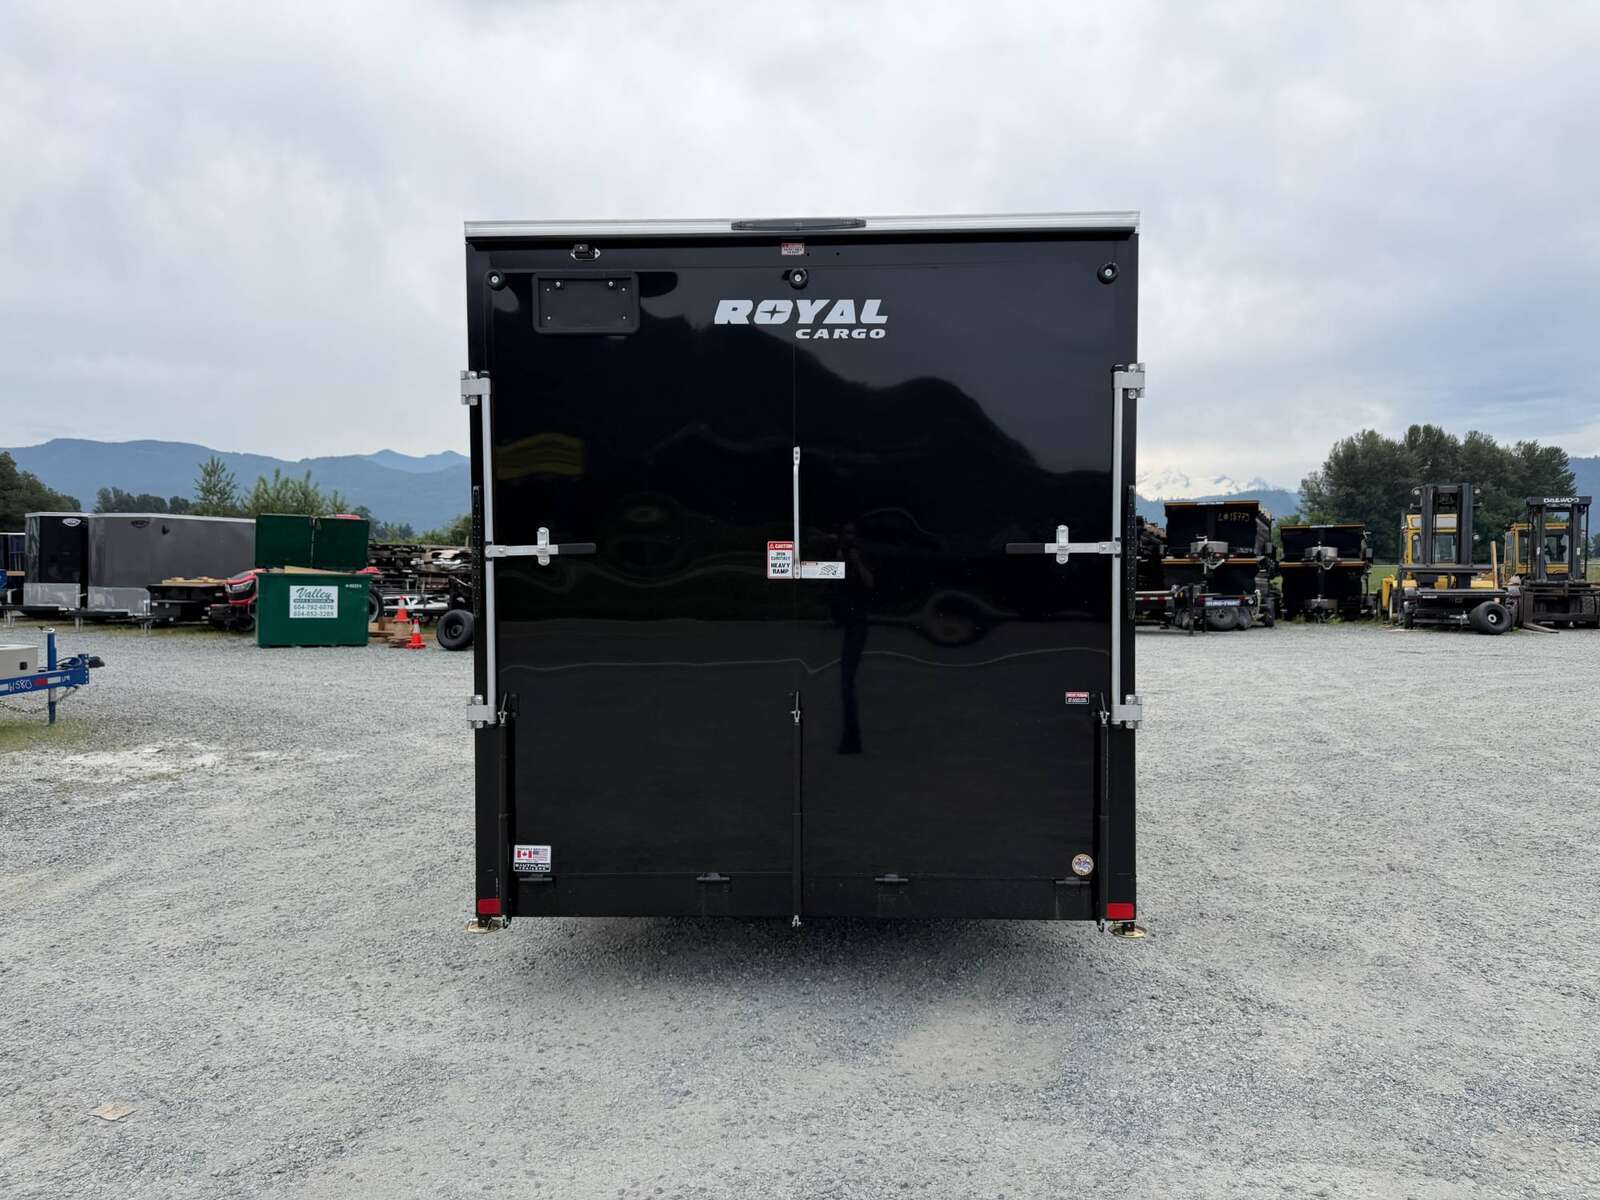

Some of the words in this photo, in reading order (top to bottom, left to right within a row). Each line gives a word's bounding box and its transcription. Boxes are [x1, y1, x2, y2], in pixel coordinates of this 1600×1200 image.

[714, 299, 888, 325] ROYAL
[795, 328, 886, 340] CARGO
[296, 587, 332, 599] Valley
